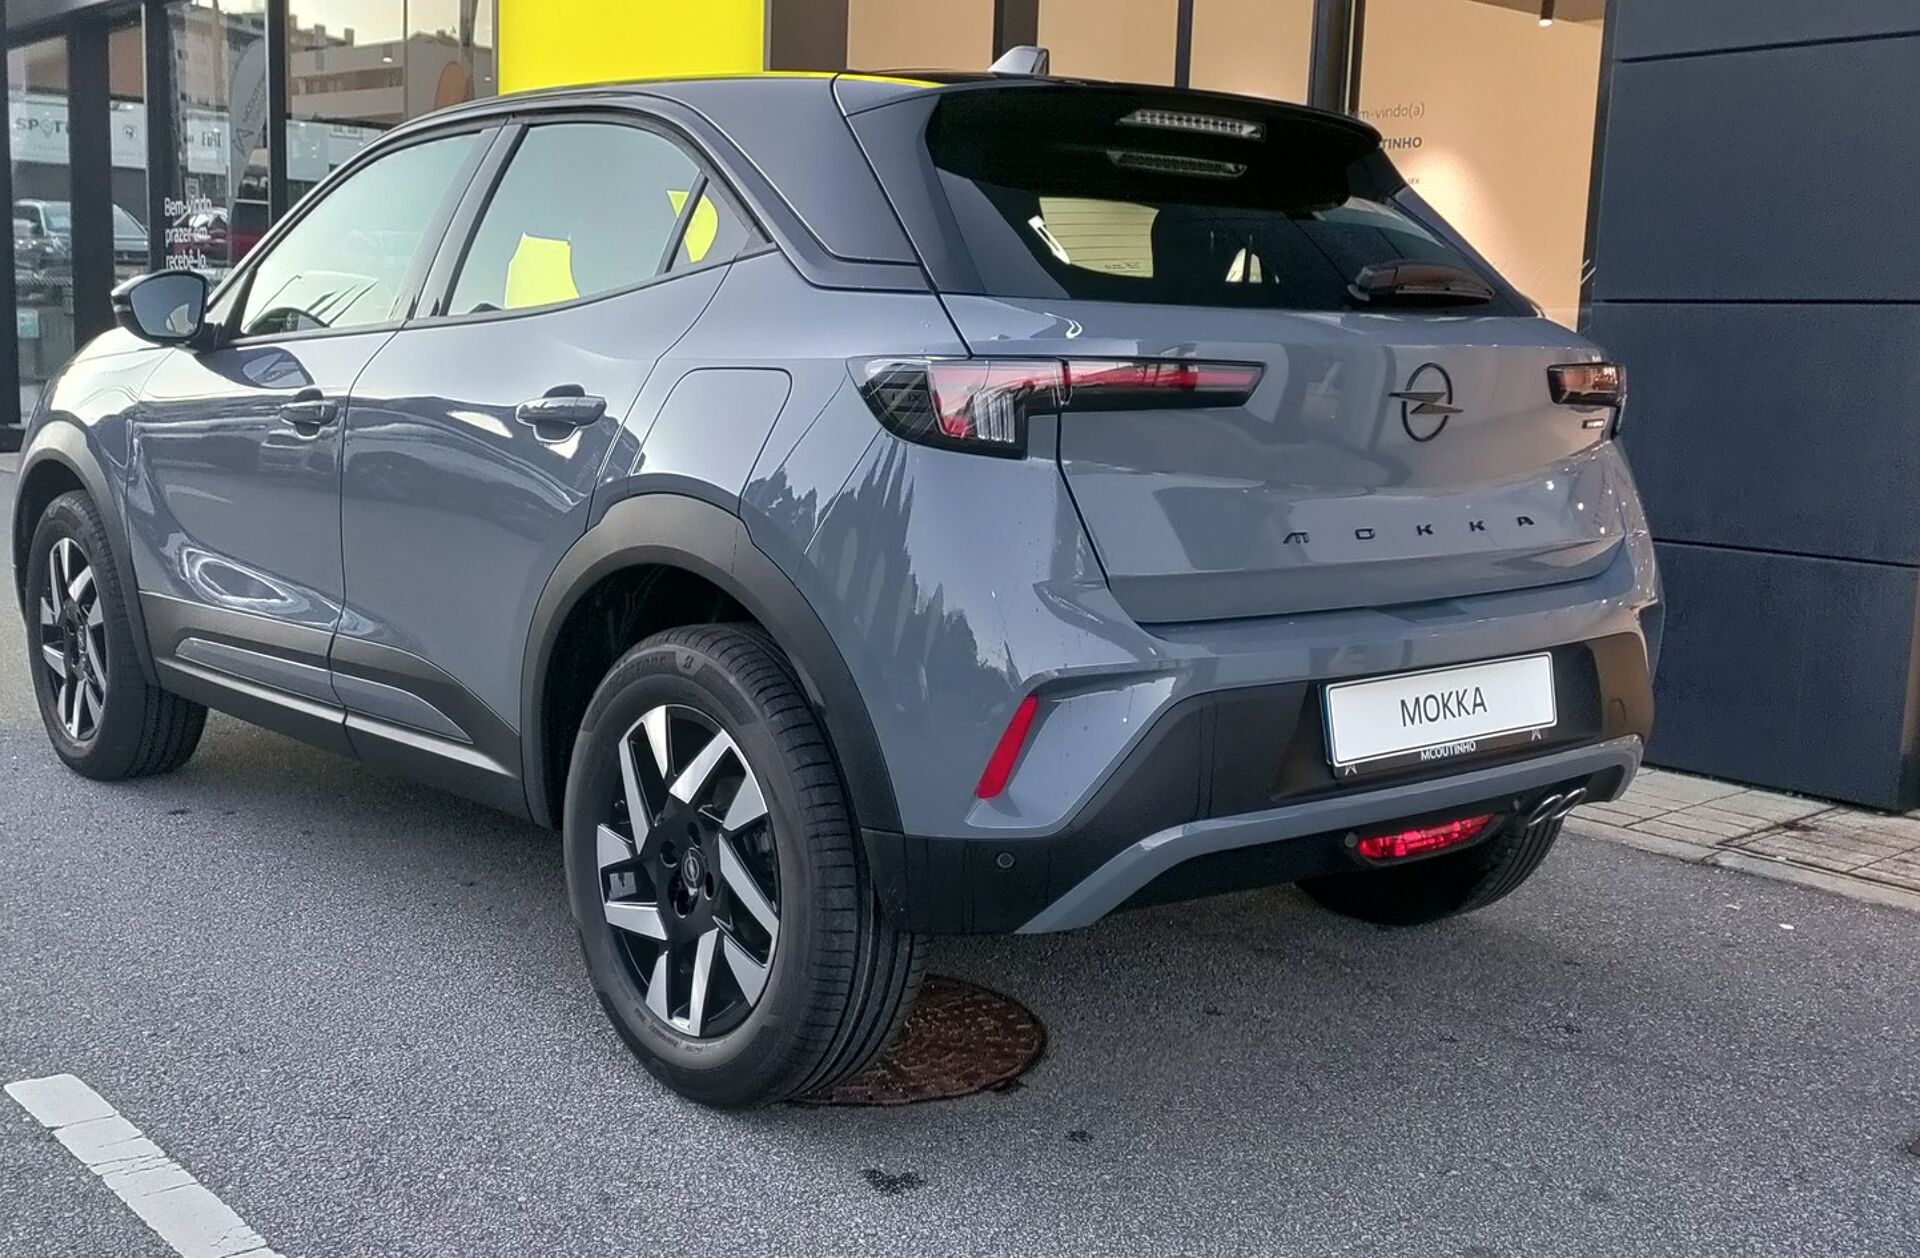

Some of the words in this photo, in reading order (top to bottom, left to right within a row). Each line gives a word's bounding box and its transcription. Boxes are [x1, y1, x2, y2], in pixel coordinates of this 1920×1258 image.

[1283, 516, 1535, 544] MOKKA
[1400, 686, 1488, 727] MOKKA
[1420, 740, 1477, 760] MCOUTINHO
